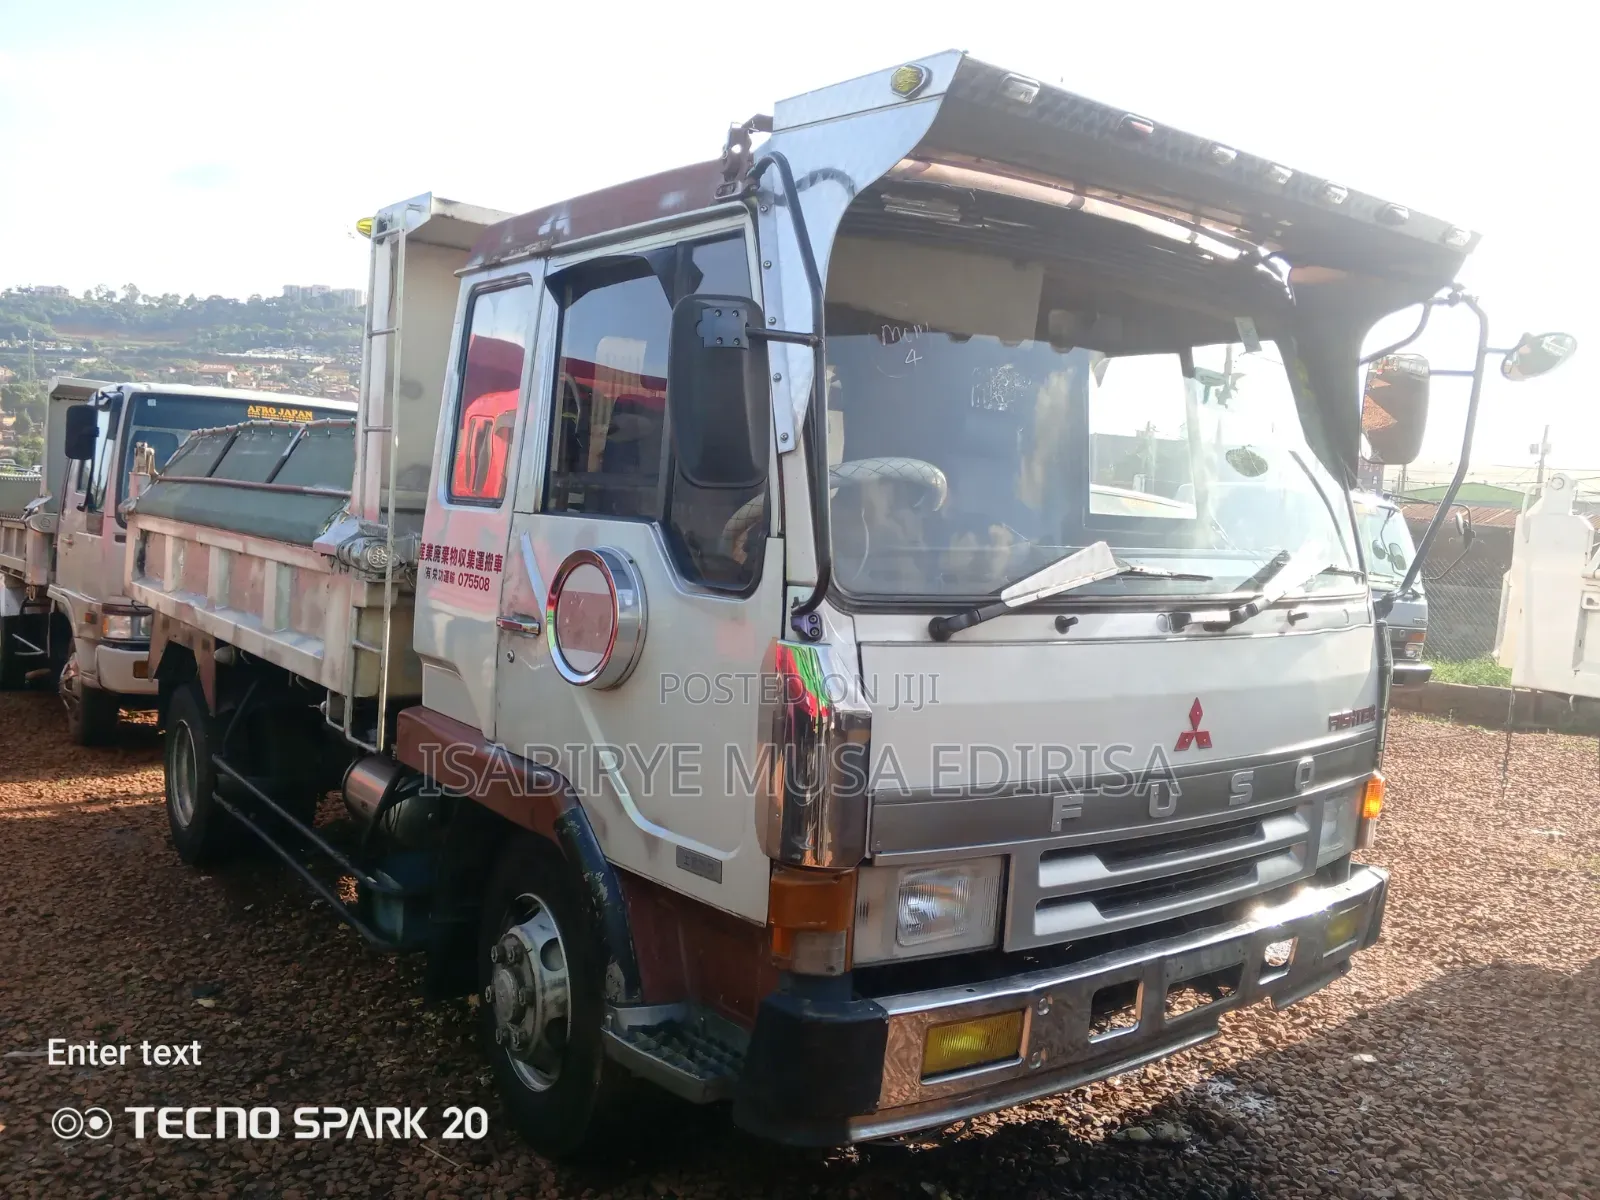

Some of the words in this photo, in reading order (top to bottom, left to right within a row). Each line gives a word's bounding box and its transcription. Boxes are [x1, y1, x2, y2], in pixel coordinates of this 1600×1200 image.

[905, 348, 923, 366] 4
[248, 405, 277, 415] AFRO
[278, 408, 313, 419] JAPAN
[458, 573, 490, 591] 075508
[1051, 756, 1316, 833] FUSO
